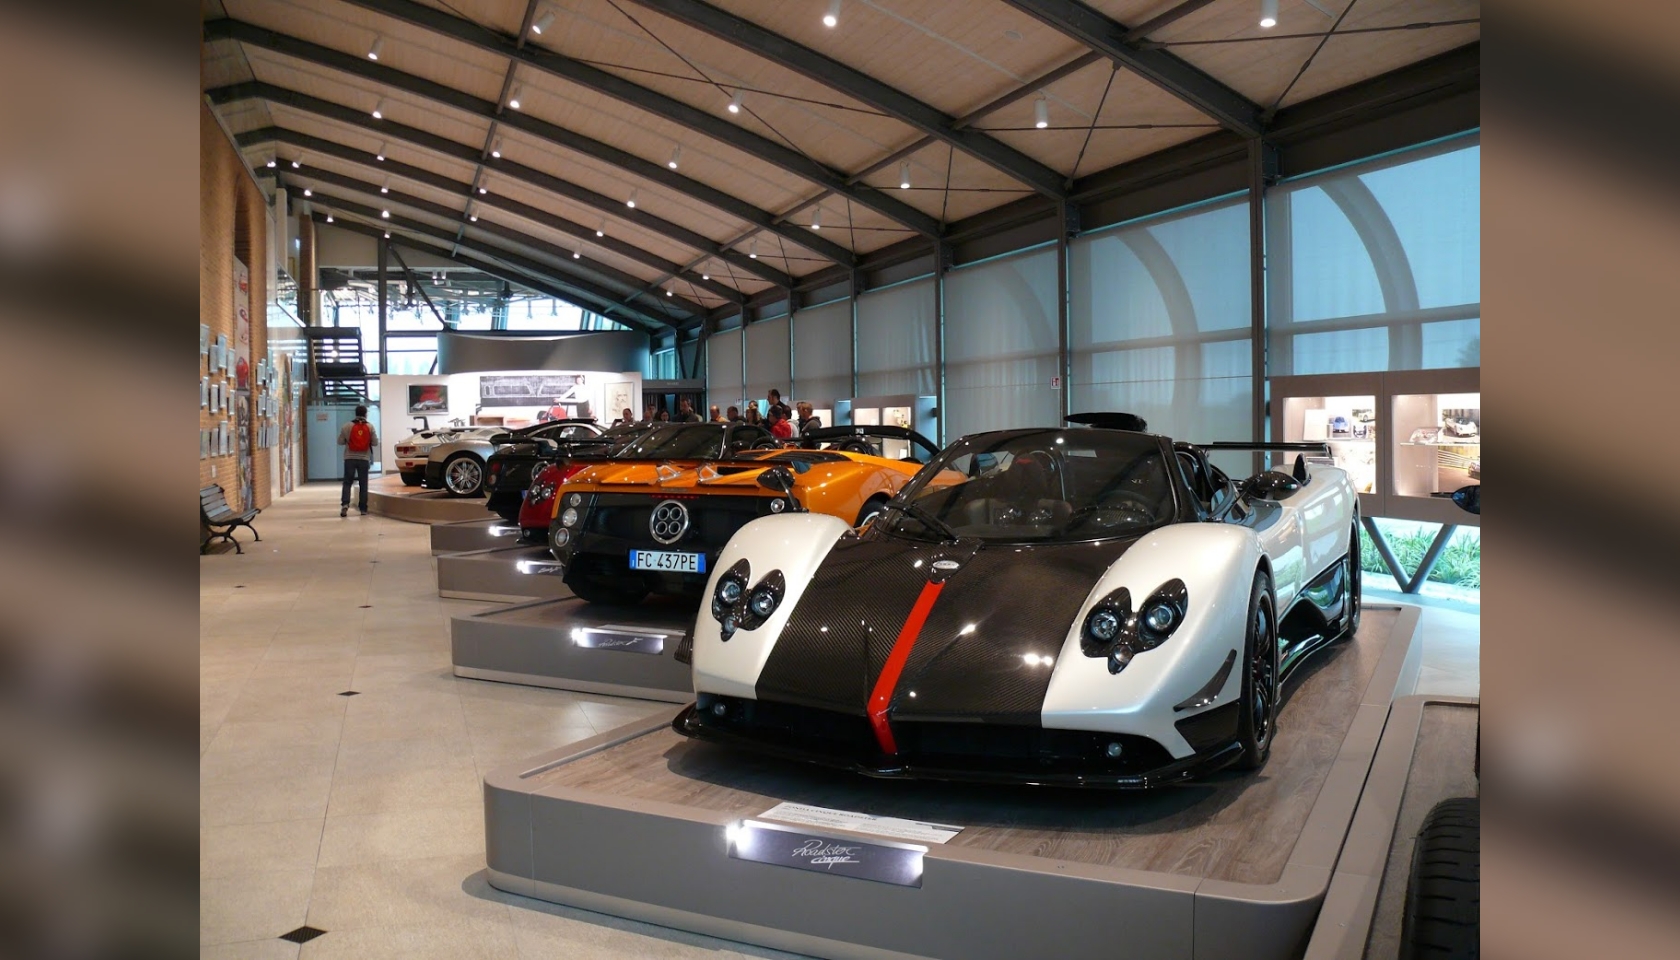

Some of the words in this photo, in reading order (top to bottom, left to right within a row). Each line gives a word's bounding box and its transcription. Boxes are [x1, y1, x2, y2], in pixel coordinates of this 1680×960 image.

[637, 552, 652, 568] FC
[657, 553, 697, 570] 437PE
[791, 839, 862, 857] Roadster
